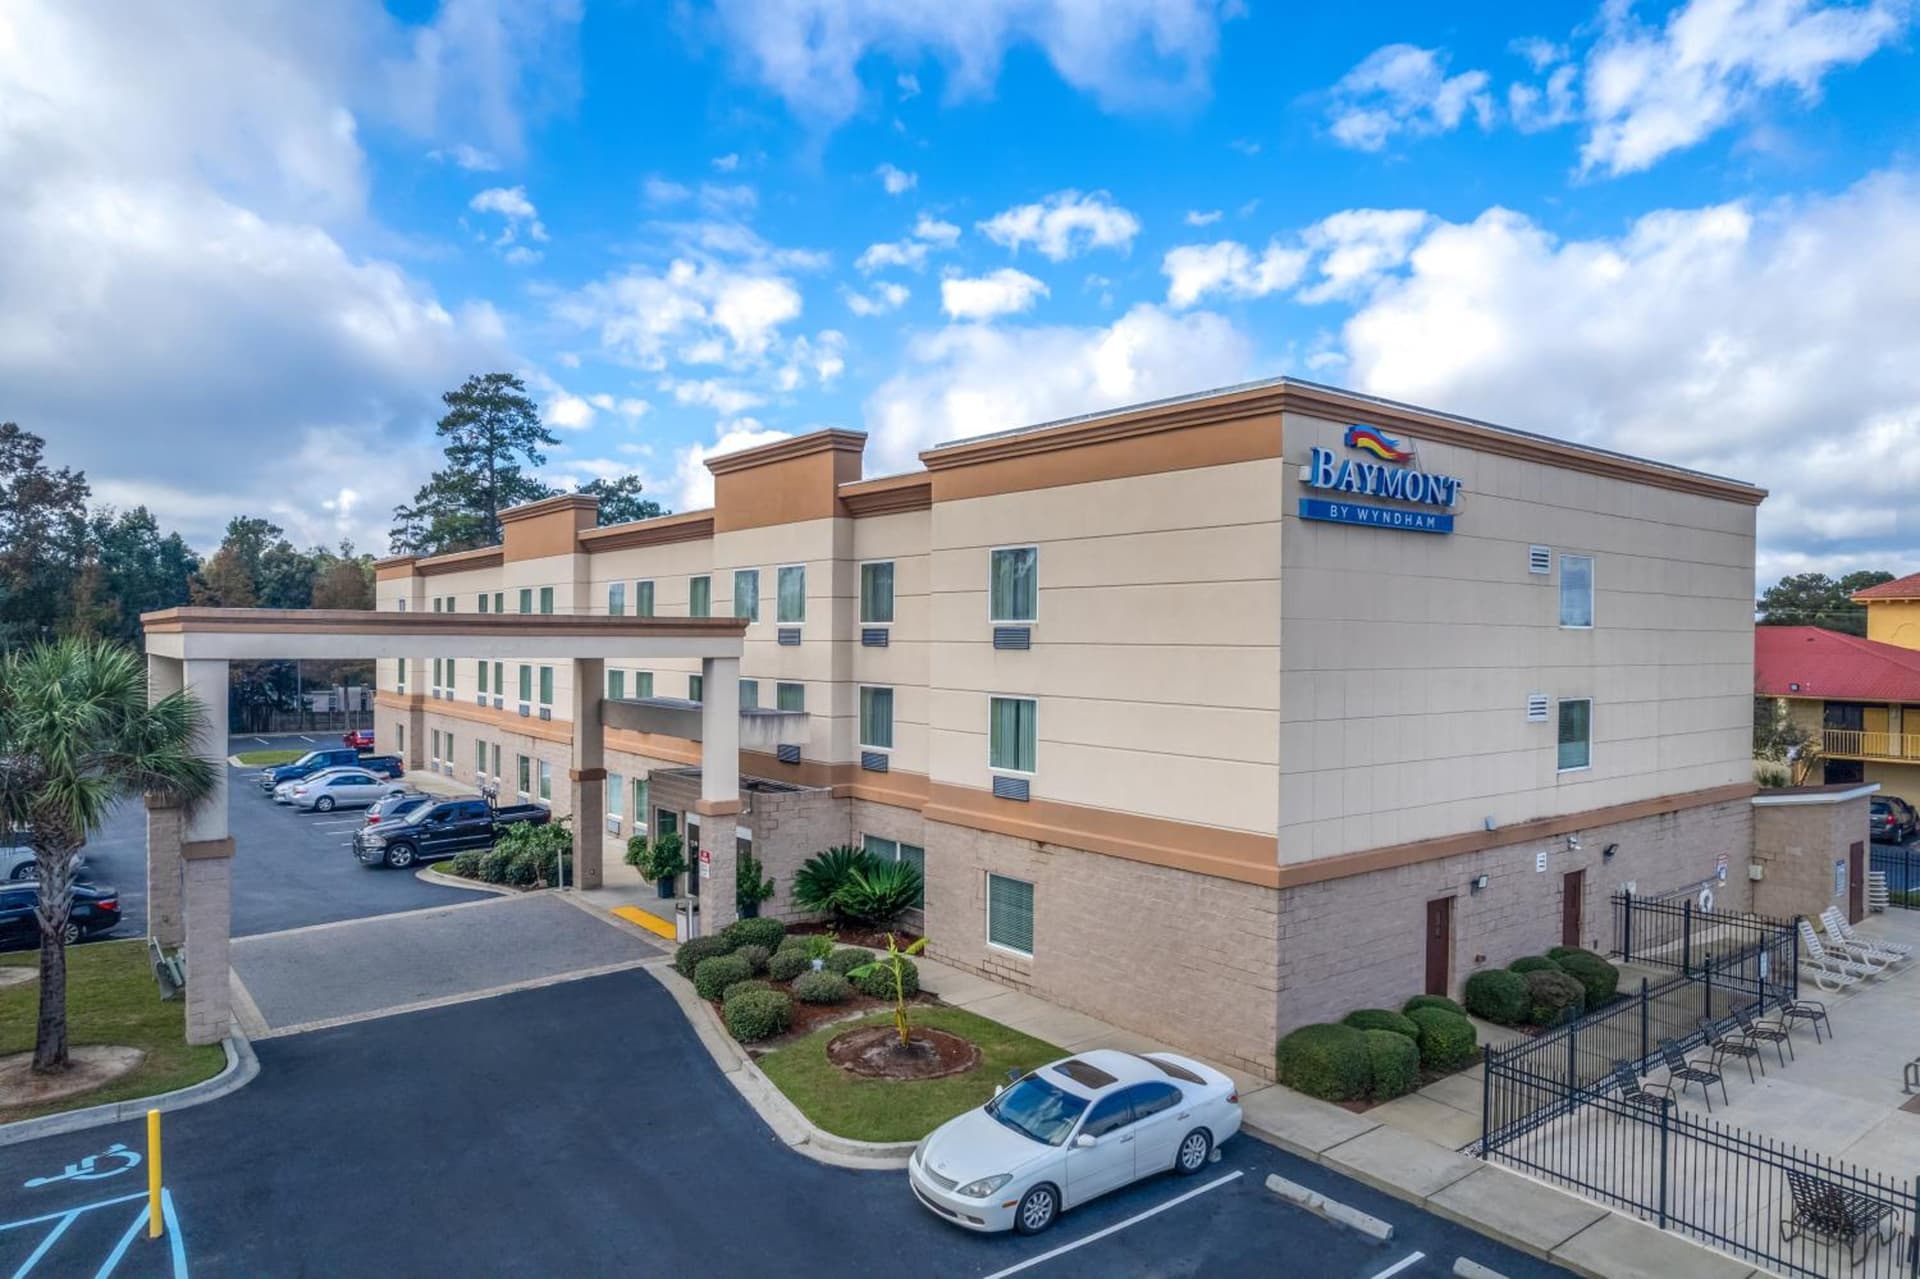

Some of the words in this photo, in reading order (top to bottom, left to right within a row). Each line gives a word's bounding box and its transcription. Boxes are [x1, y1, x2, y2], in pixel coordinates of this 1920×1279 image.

[1312, 447, 1462, 506] BAYMONT
[1330, 504, 1349, 519] BY
[1357, 507, 1436, 529] WYNDHAM
